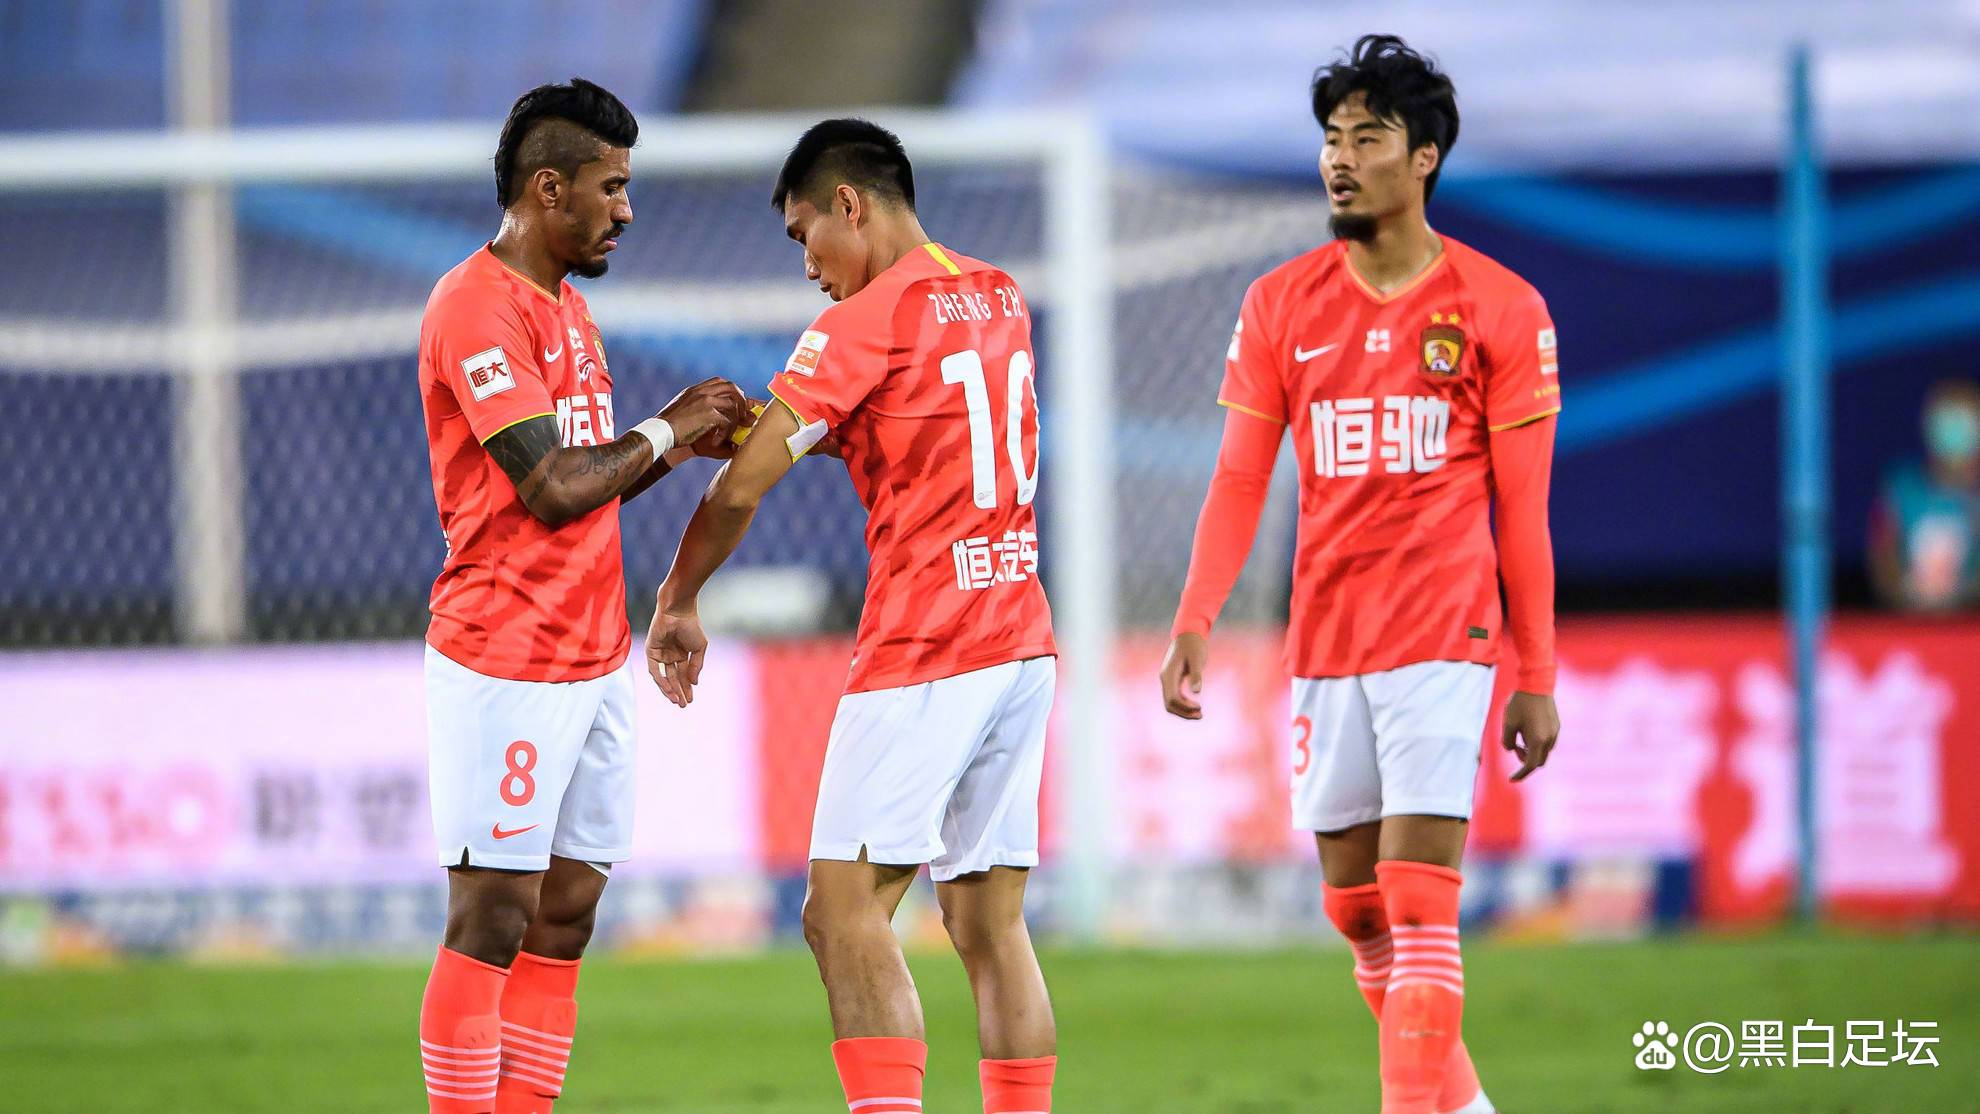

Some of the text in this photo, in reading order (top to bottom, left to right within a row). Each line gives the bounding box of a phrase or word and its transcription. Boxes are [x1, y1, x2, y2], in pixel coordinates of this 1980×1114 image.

[927, 292, 992, 324] ZHENG
[470, 361, 508, 388] 恒大
[940, 349, 1041, 509] 10
[1310, 395, 1449, 479] 恒驰
[499, 740, 538, 806] 8
[1293, 714, 1312, 776] 3
